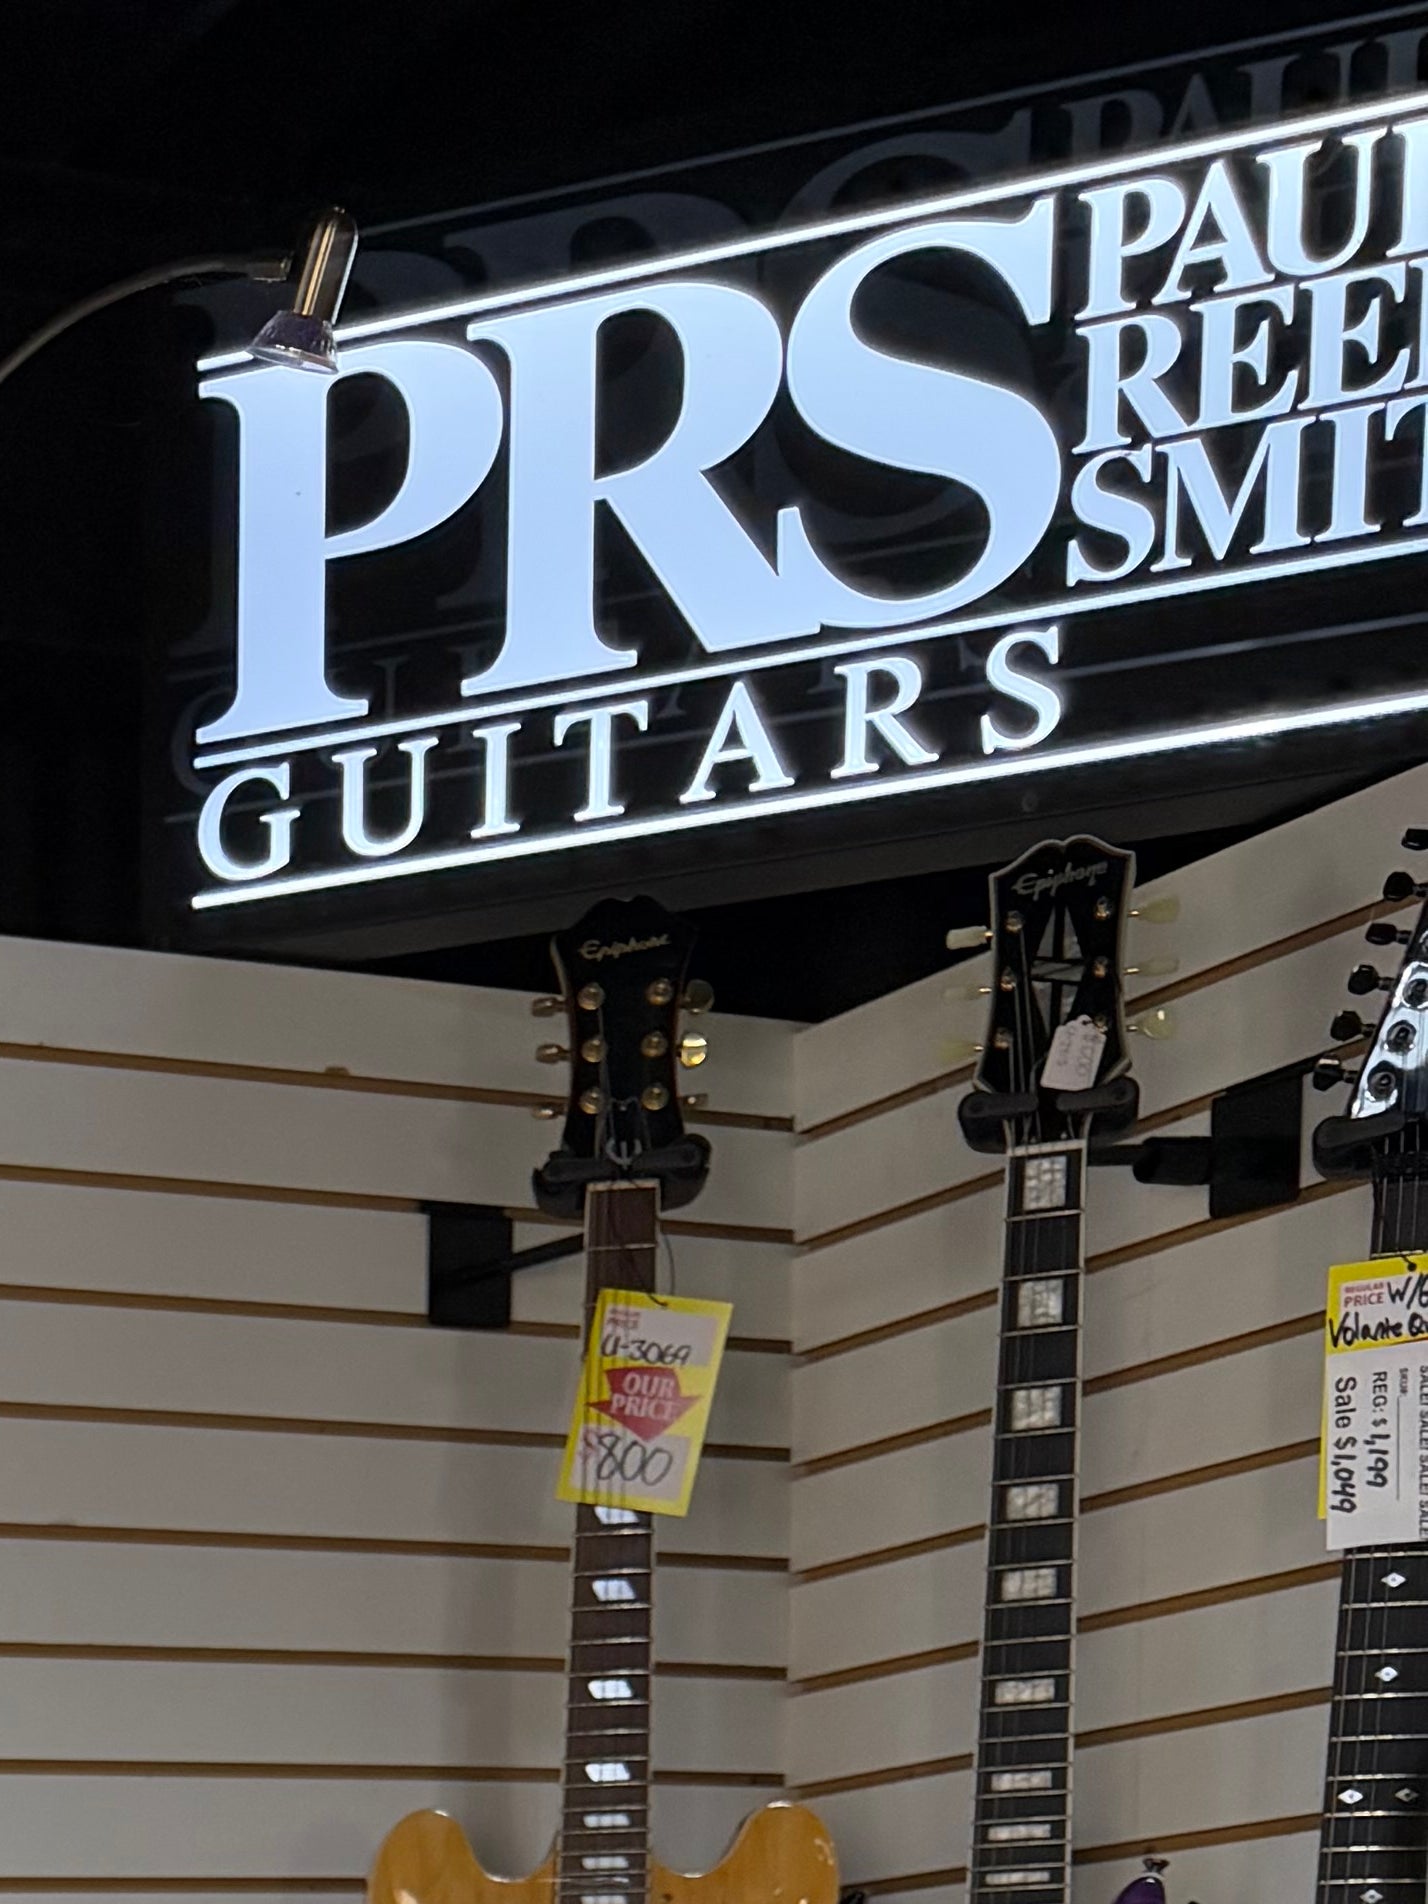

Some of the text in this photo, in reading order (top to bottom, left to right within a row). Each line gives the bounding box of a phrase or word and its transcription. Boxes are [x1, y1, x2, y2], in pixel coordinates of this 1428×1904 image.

[1072, 257, 1428, 454] REE
[196, 198, 1062, 746] PRS
[194, 625, 1063, 883] GUITARS
[1344, 1293, 1384, 1308] PRICE
[610, 1393, 676, 1421] PRICE
[622, 1373, 676, 1398] OUR
[1334, 1376, 1357, 1428] Sale
[1371, 1370, 1388, 1413] REG:
